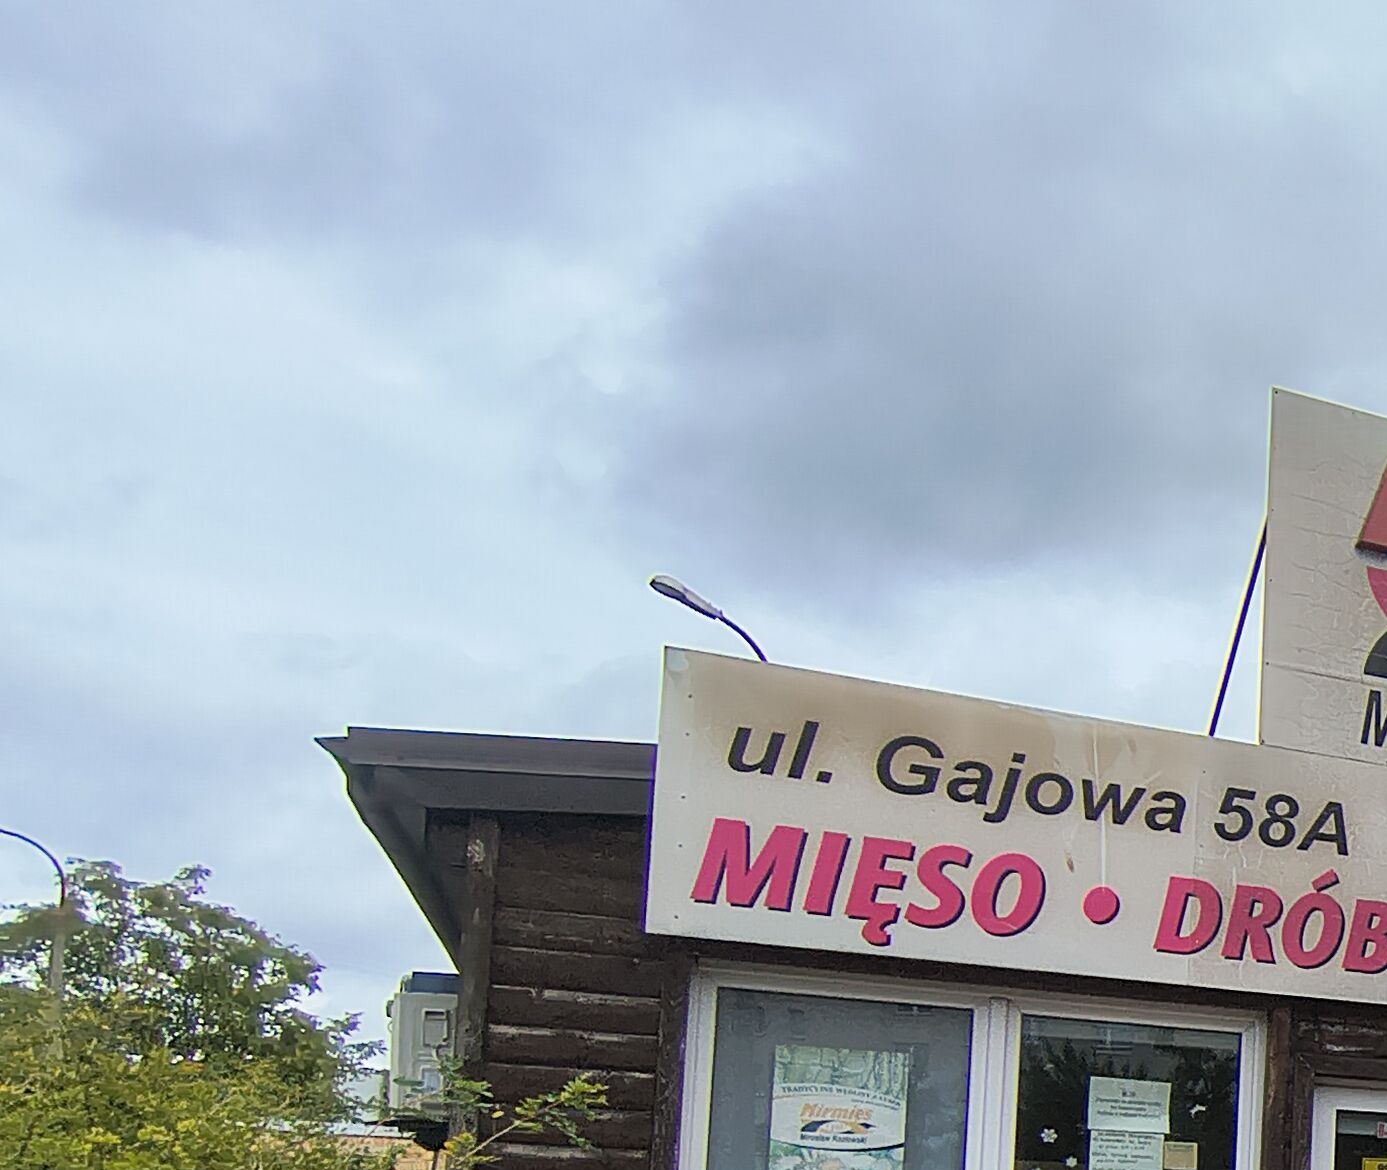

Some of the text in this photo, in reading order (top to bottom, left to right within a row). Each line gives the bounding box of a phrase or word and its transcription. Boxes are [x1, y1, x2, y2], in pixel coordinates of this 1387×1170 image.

[726, 720, 1350, 856] ul. Gajowa 58A
[690, 817, 1047, 947] MIĘSO
